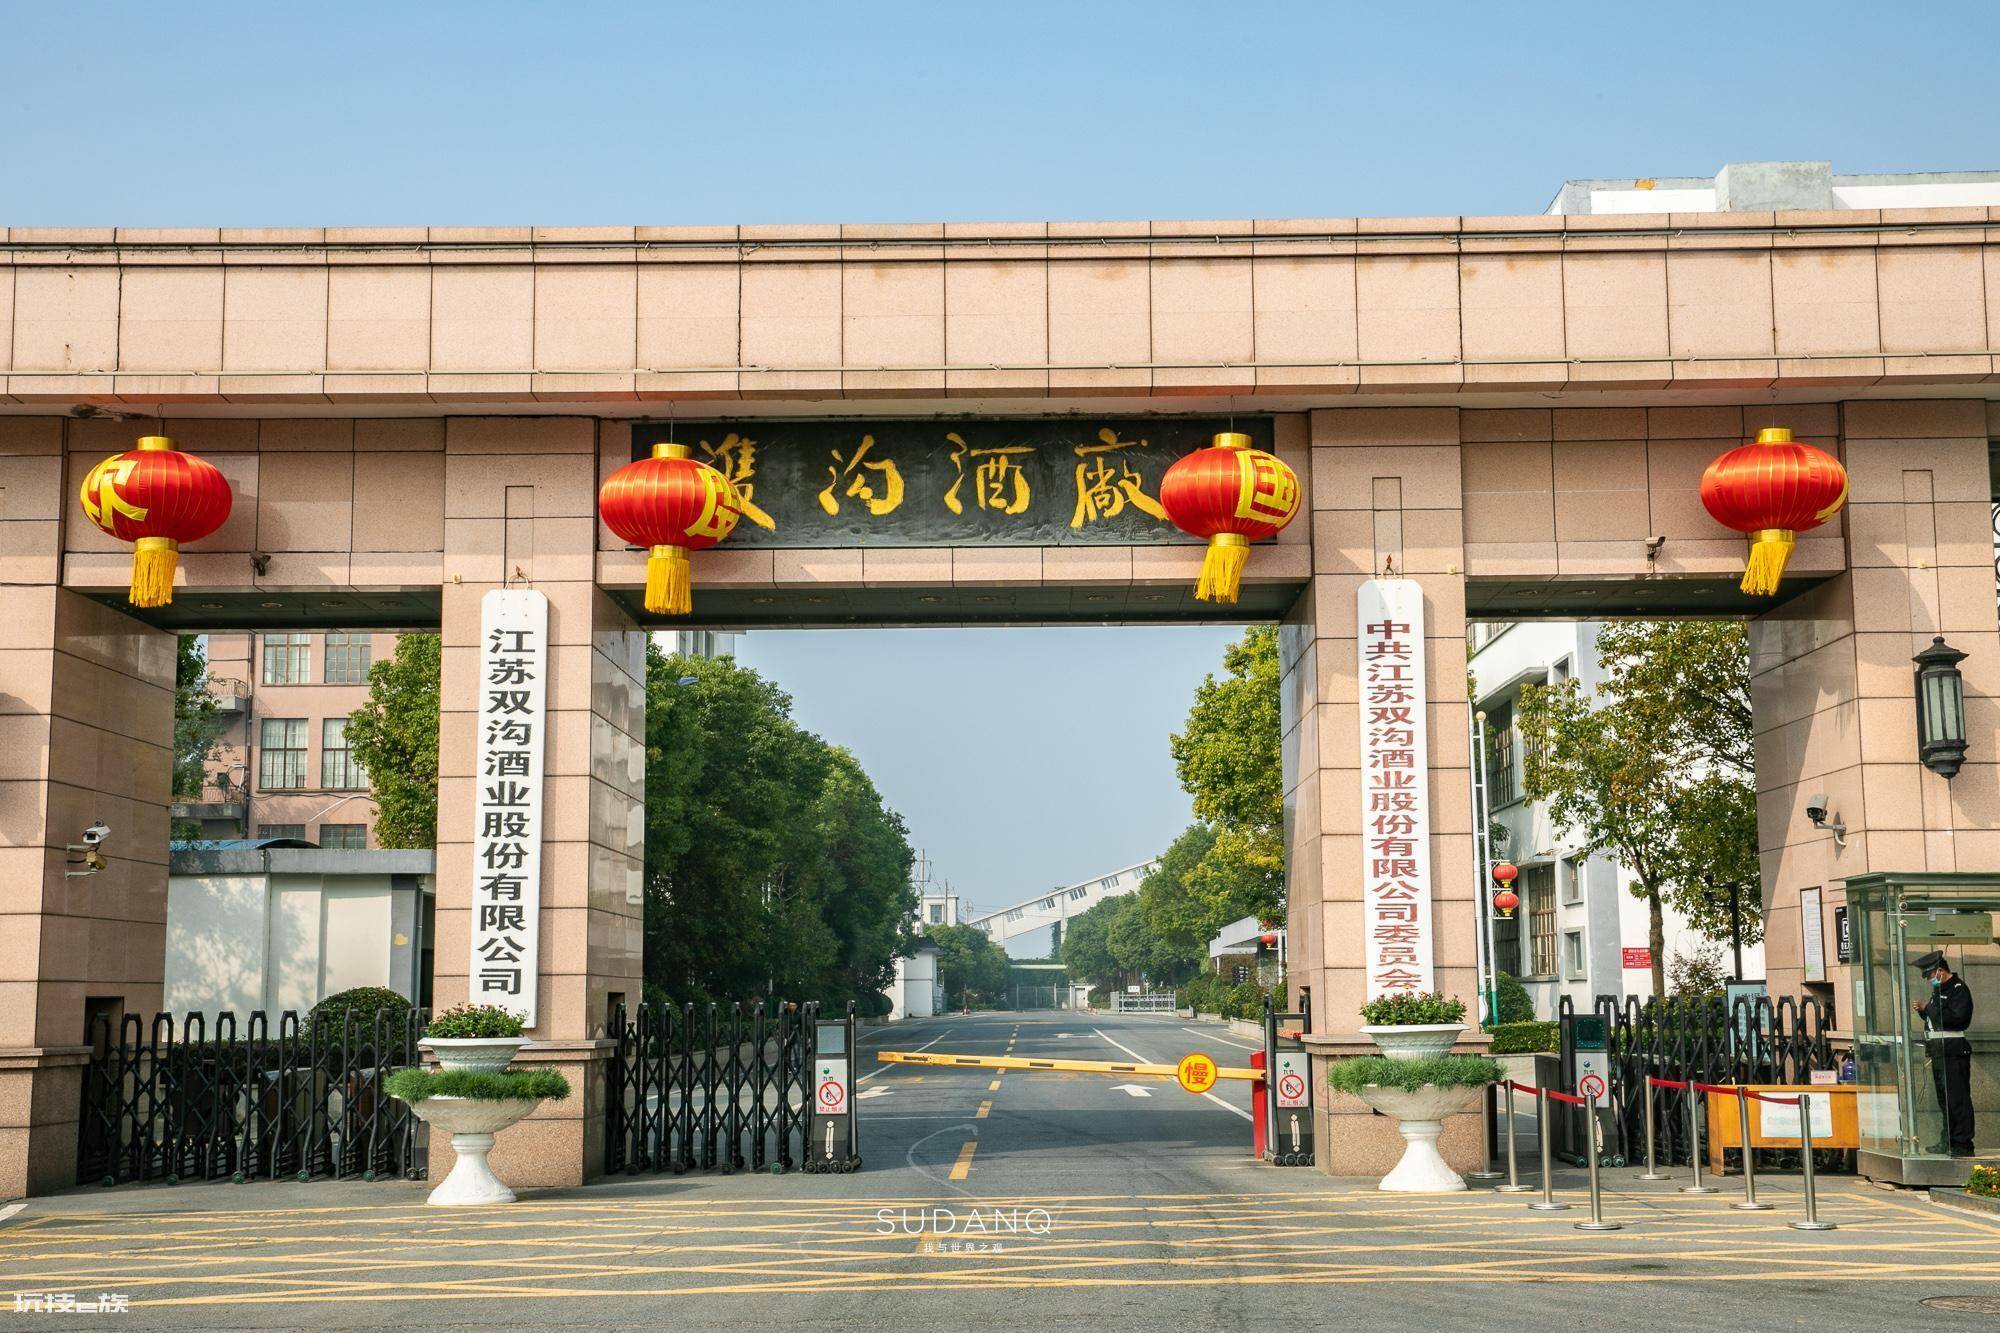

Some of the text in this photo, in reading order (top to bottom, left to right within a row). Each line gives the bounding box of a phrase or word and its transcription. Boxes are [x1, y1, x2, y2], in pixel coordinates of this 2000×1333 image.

[1235, 450, 1300, 528] 国
[477, 628, 536, 995] 江苏双沟酒业股份有限公司
[1365, 619, 1421, 990] 中共江苏双沟酒业股份有限公司委员会
[1185, 1062, 1208, 1085] 慢
